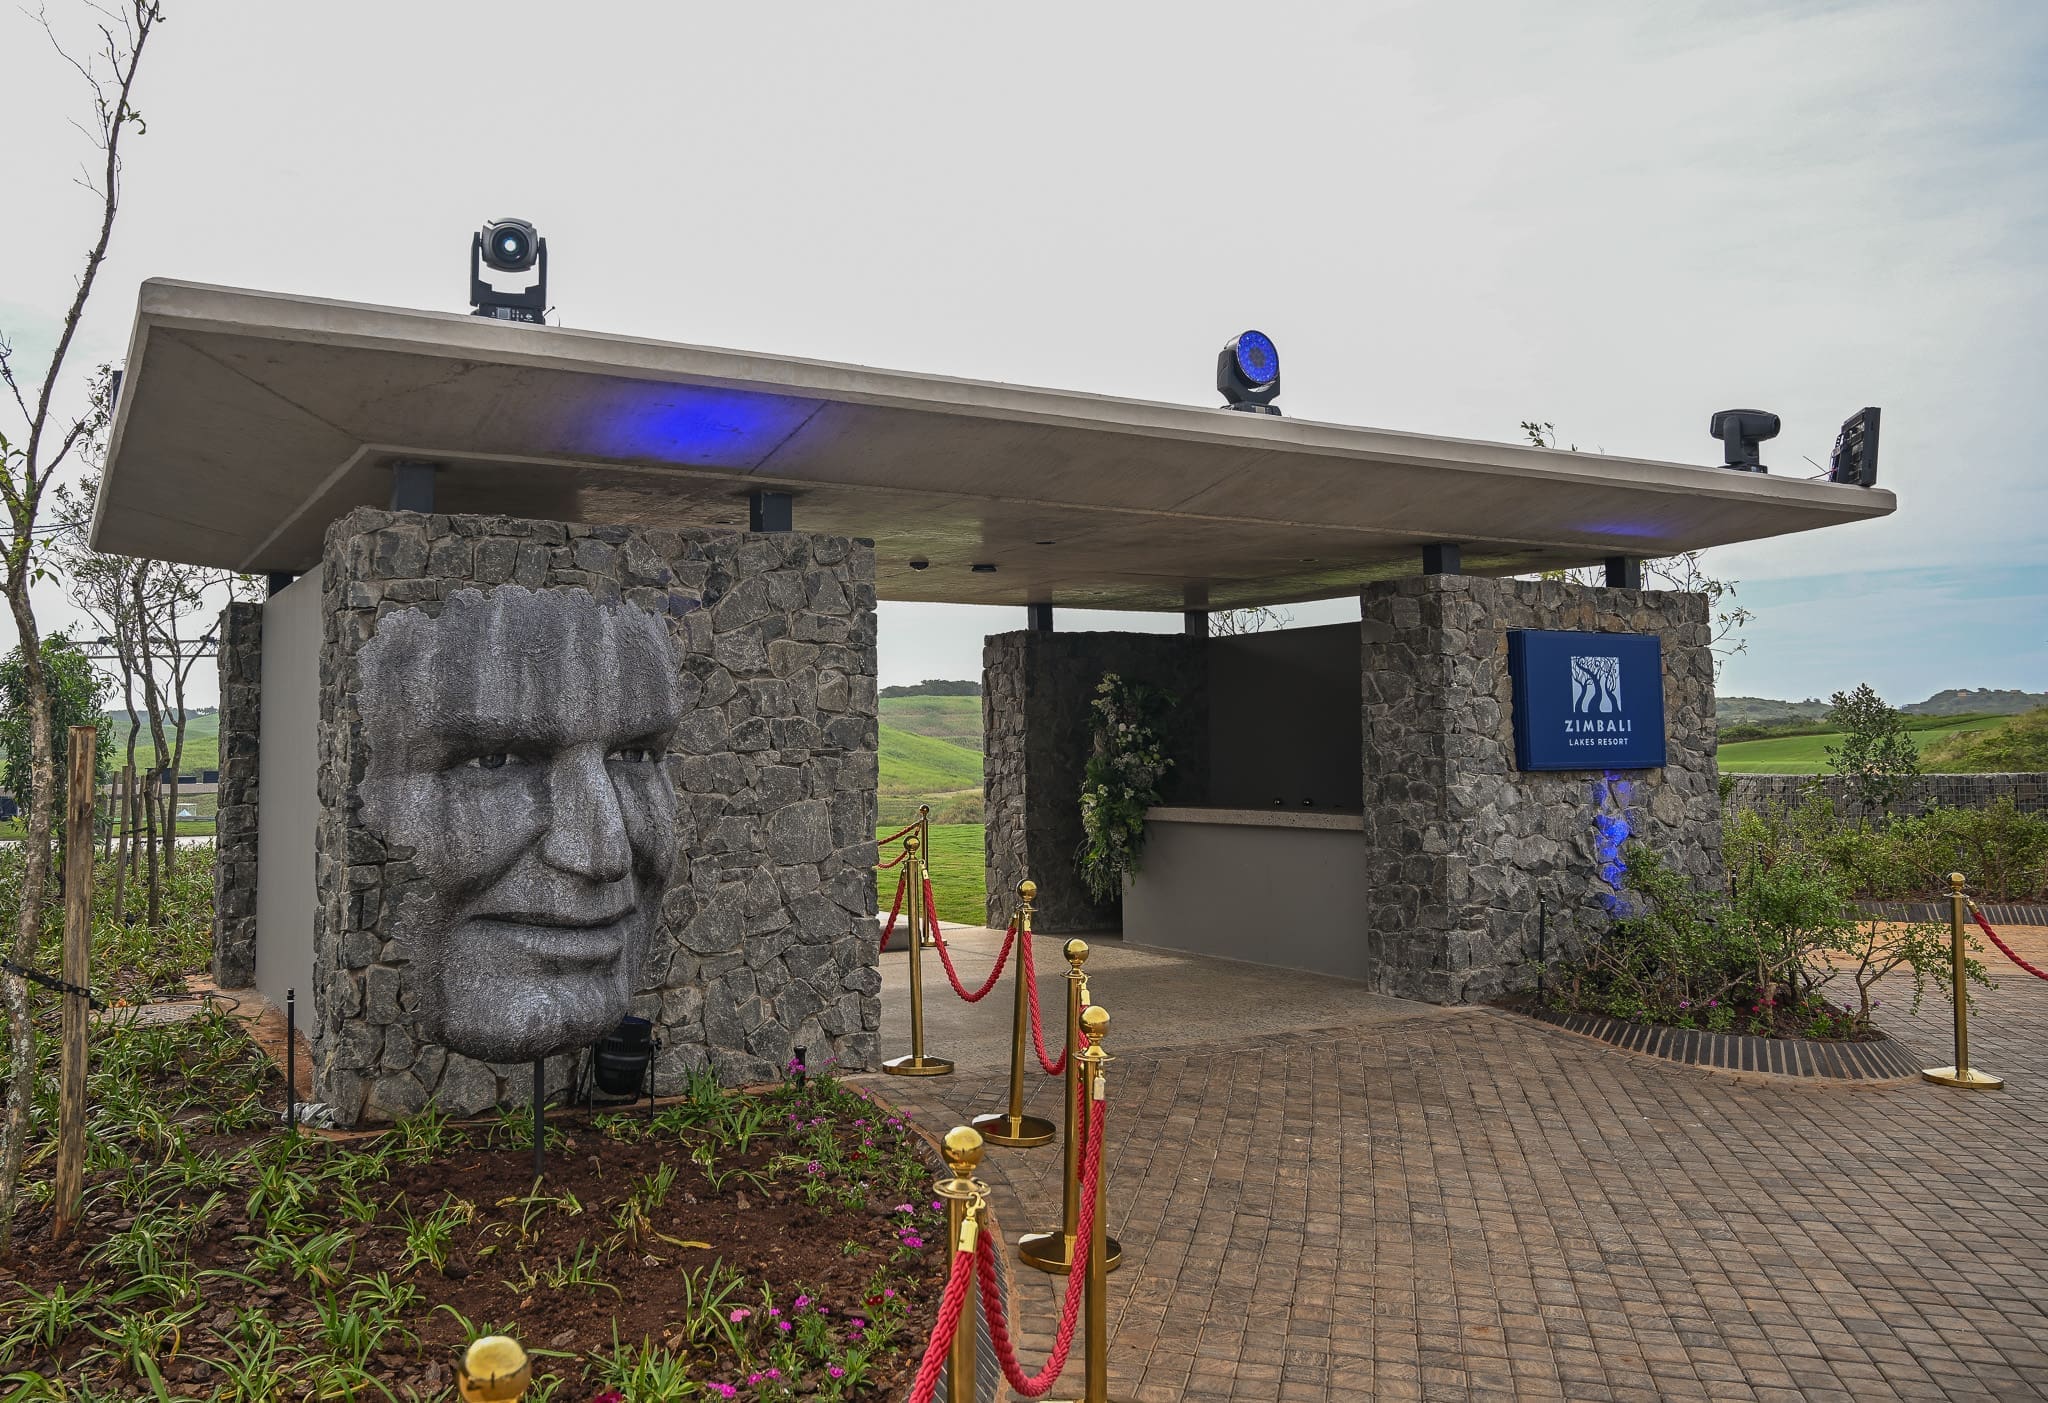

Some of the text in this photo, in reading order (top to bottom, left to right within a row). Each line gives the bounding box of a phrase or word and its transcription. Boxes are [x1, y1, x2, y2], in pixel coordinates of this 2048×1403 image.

[1564, 719, 1632, 733] ZIMBALI
[1568, 737, 1629, 746] LAKES RESORT
